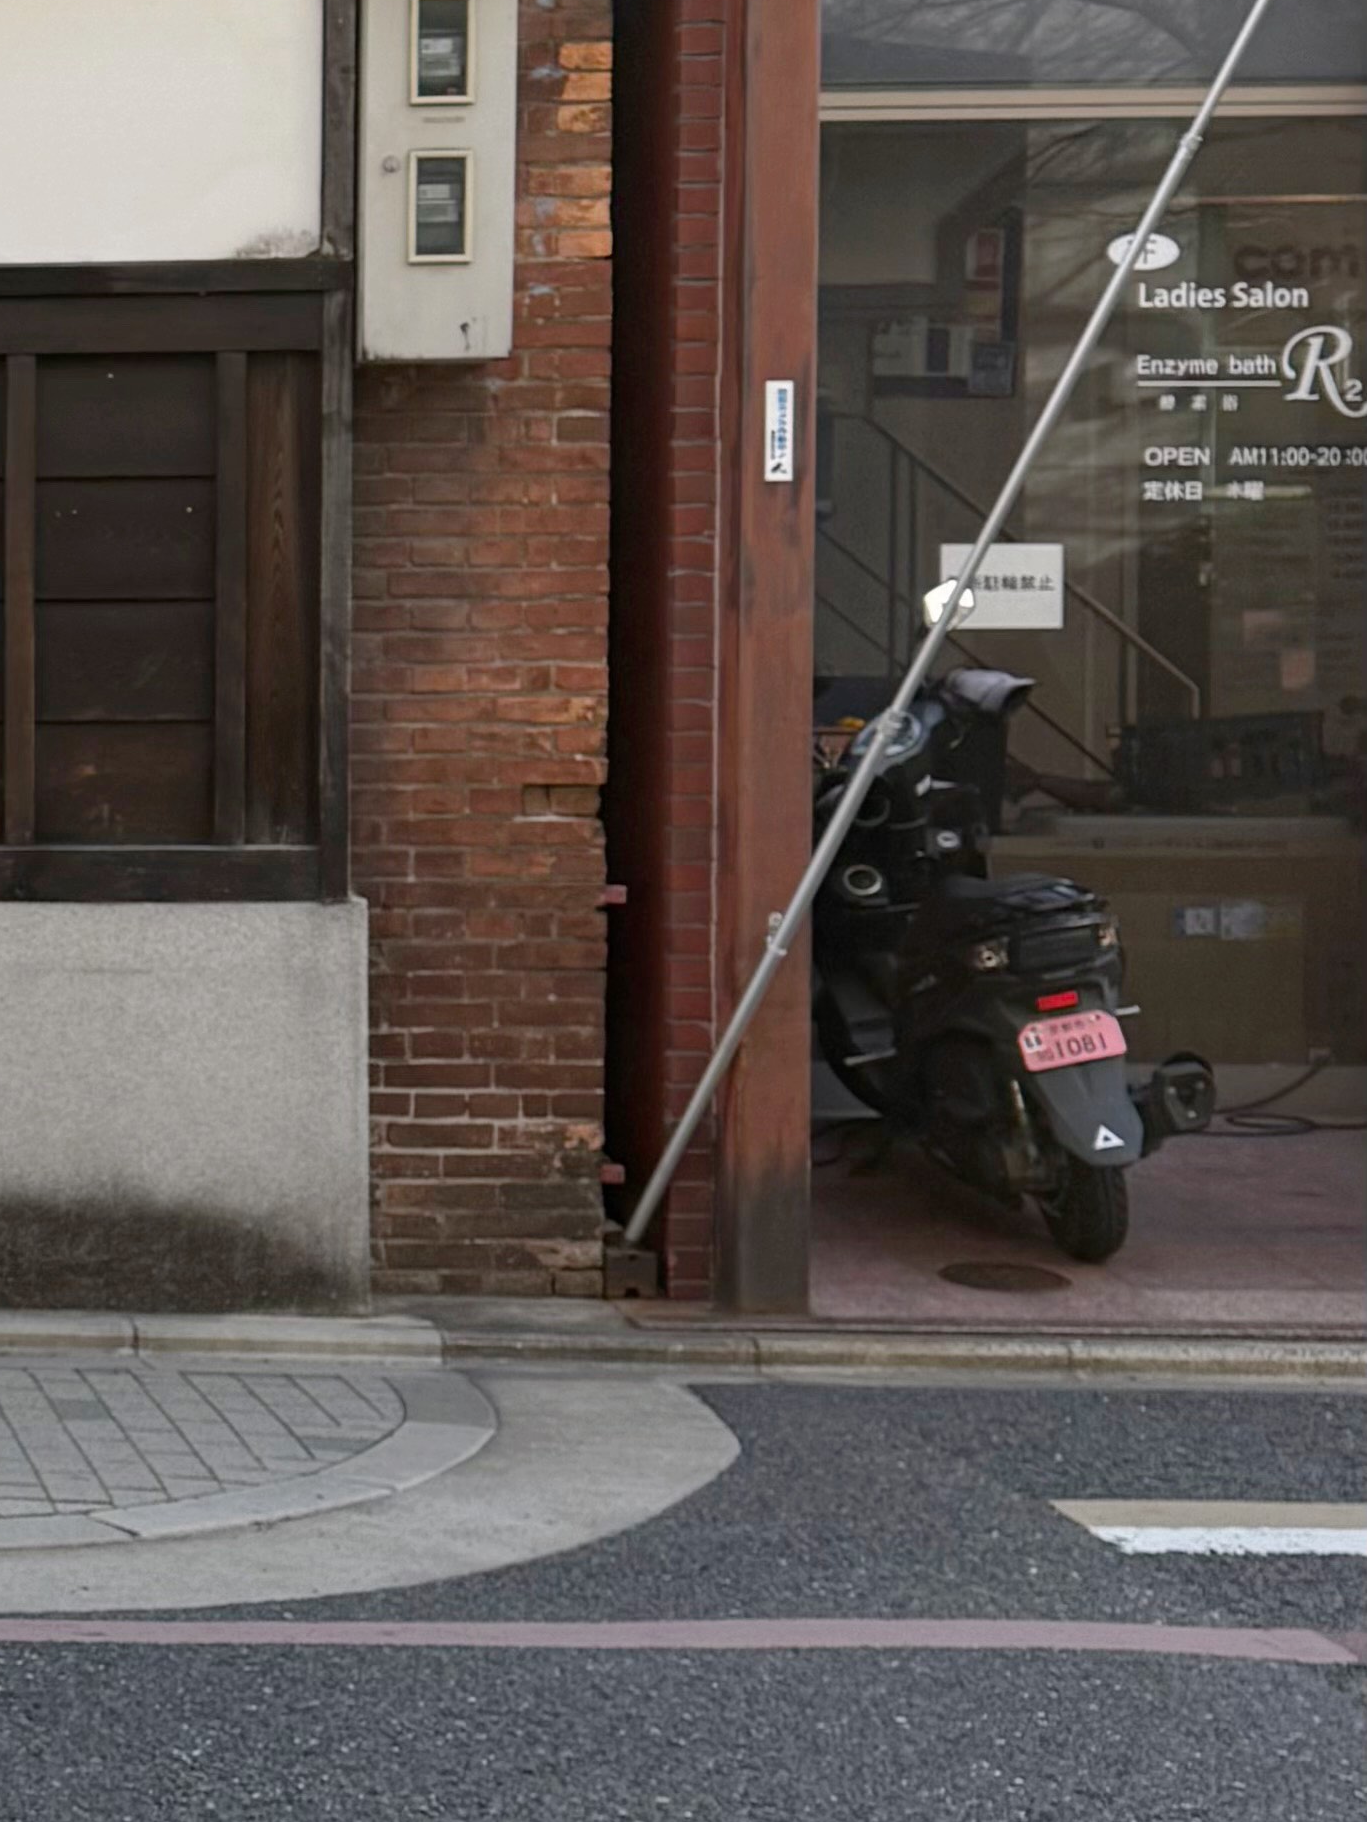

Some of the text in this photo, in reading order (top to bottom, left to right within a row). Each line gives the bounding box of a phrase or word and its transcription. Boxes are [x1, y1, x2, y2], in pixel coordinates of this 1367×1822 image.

[1138, 280, 1309, 309] Ladies Salon
[1136, 354, 1219, 376] Enzyme
[1229, 354, 1277, 375] bath
[1144, 446, 1211, 467] OPEN
[1142, 480, 1204, 501] 定休日
[1054, 1031, 1107, 1058] 1081
